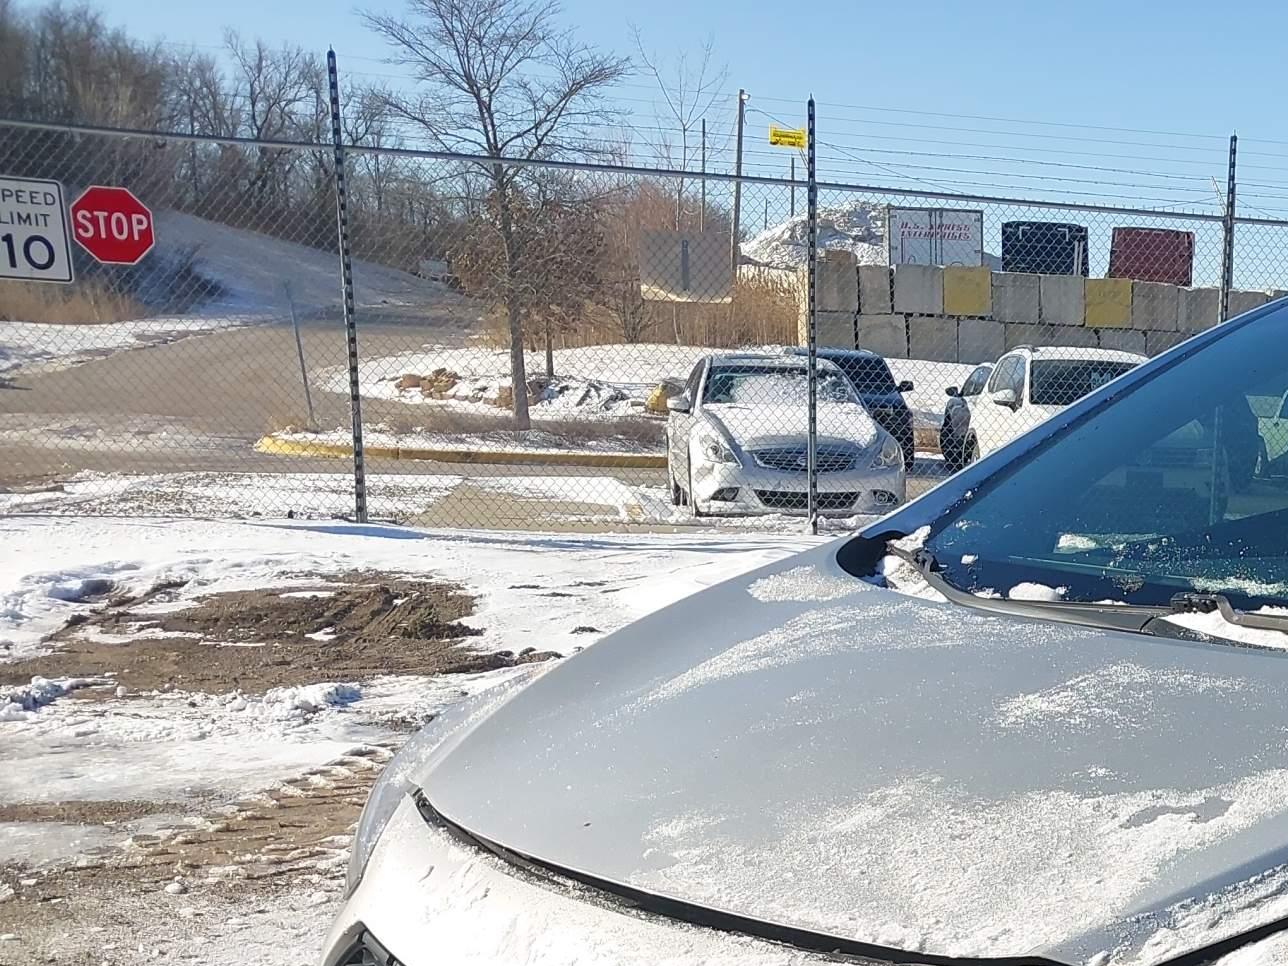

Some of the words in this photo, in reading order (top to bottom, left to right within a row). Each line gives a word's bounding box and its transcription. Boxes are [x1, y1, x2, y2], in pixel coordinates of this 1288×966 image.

[0, 188, 56, 206] PEED
[0, 211, 50, 227] LIMIT
[76, 209, 148, 241] STOP
[1, 233, 56, 270] 10
